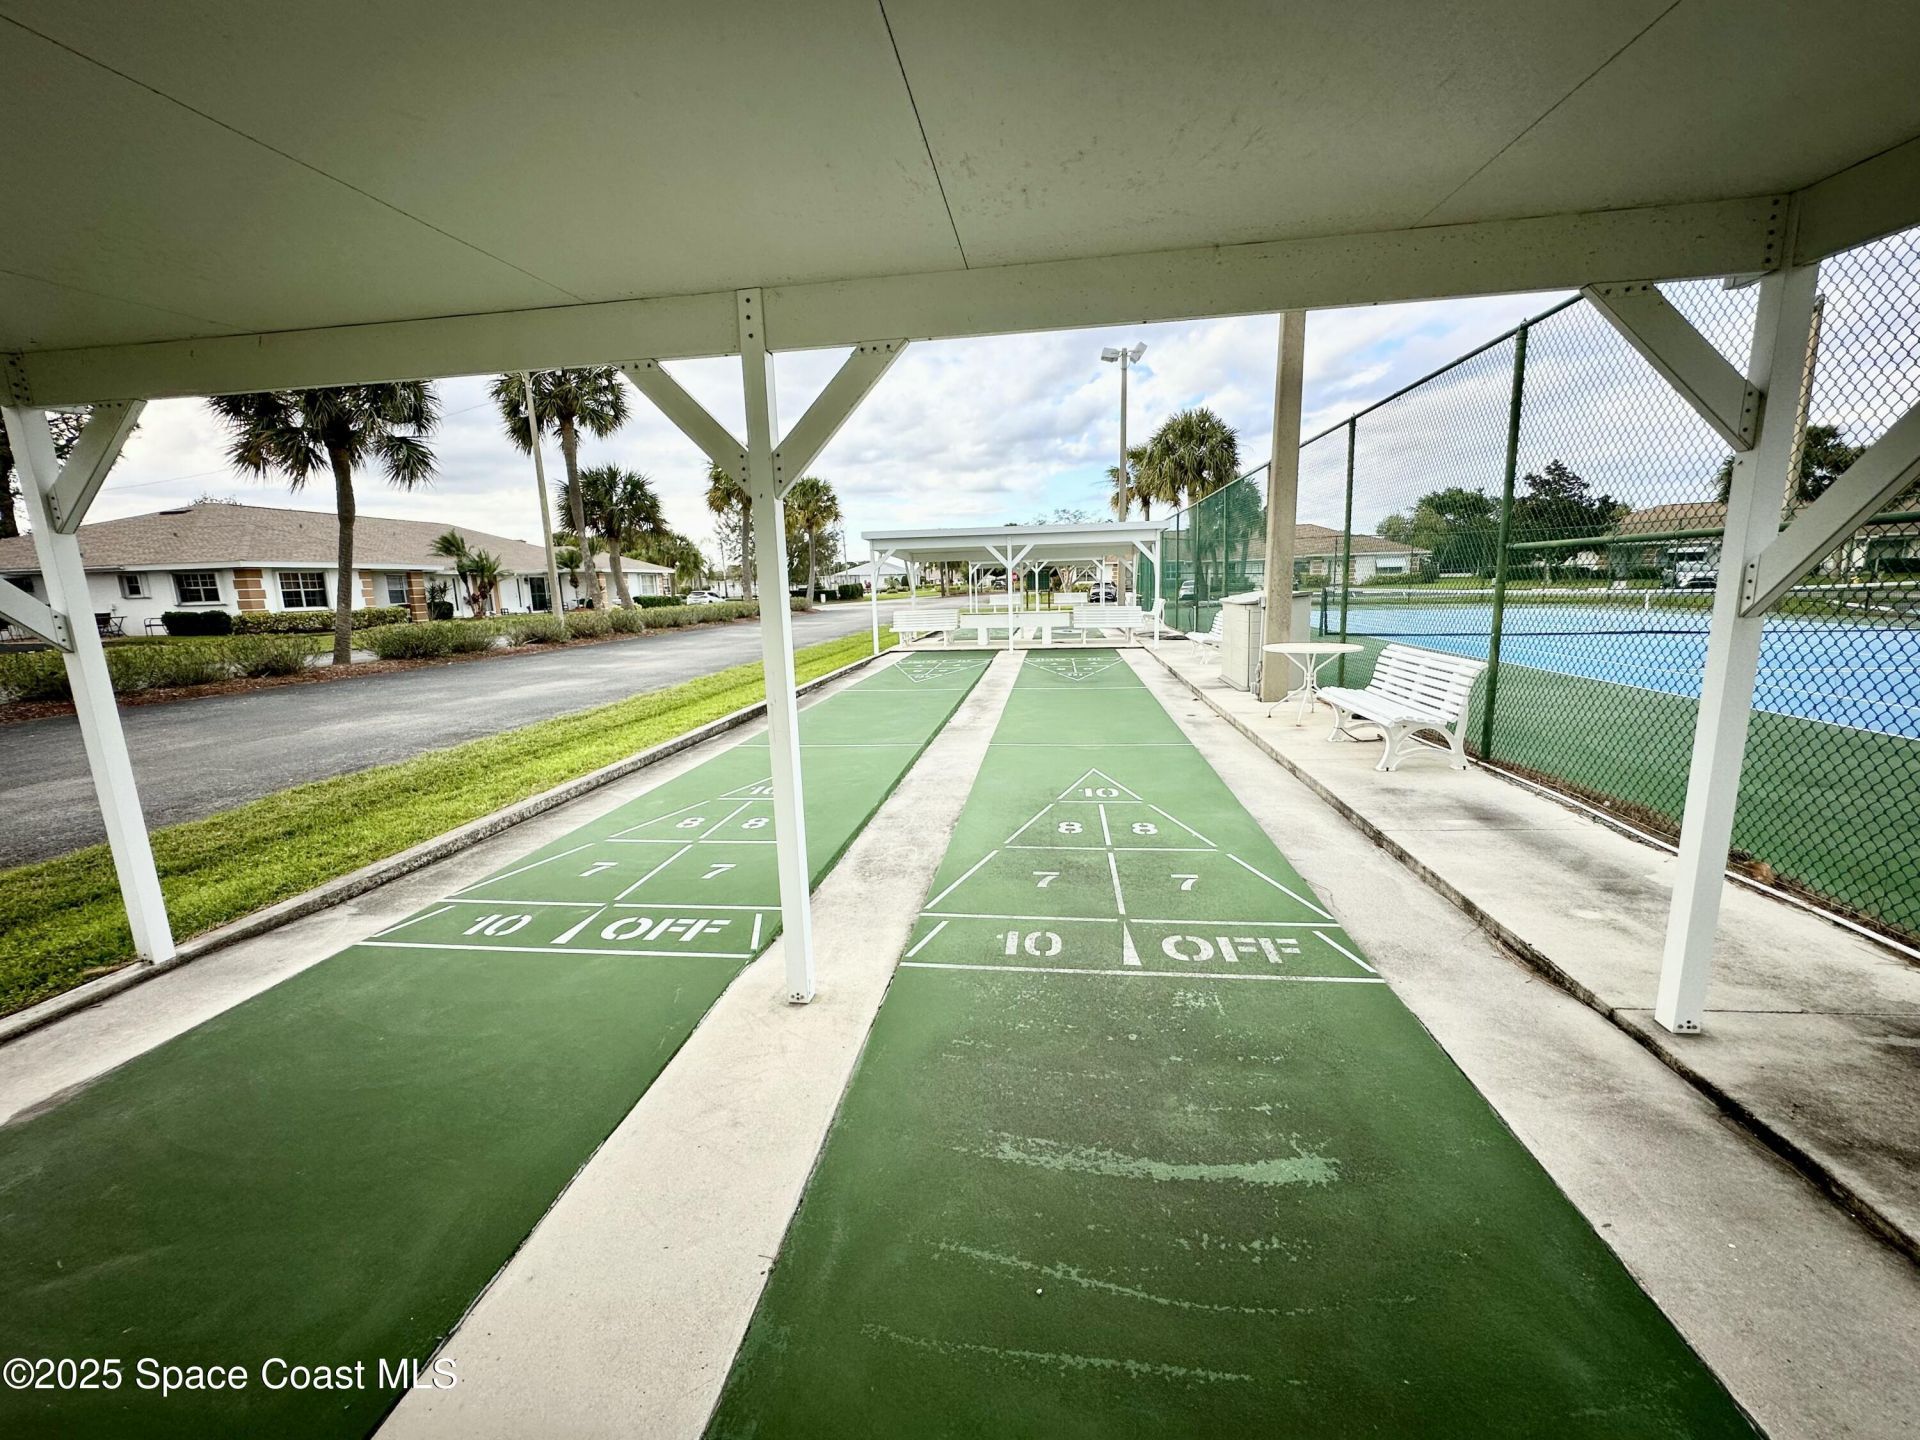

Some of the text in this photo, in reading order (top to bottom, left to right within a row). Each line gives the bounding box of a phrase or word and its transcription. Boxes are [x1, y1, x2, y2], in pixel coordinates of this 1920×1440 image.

[1078, 787, 1120, 798] 10
[676, 817, 705, 829] 8
[741, 817, 770, 829] 8
[1057, 821, 1083, 834] 8
[1132, 822, 1158, 835] 8
[579, 861, 618, 877] 7
[701, 863, 736, 879] 7
[1032, 871, 1060, 888] 7
[1170, 873, 1199, 891] 7
[462, 914, 731, 942] 10 OFF
[996, 930, 1301, 964] 10 OFF
